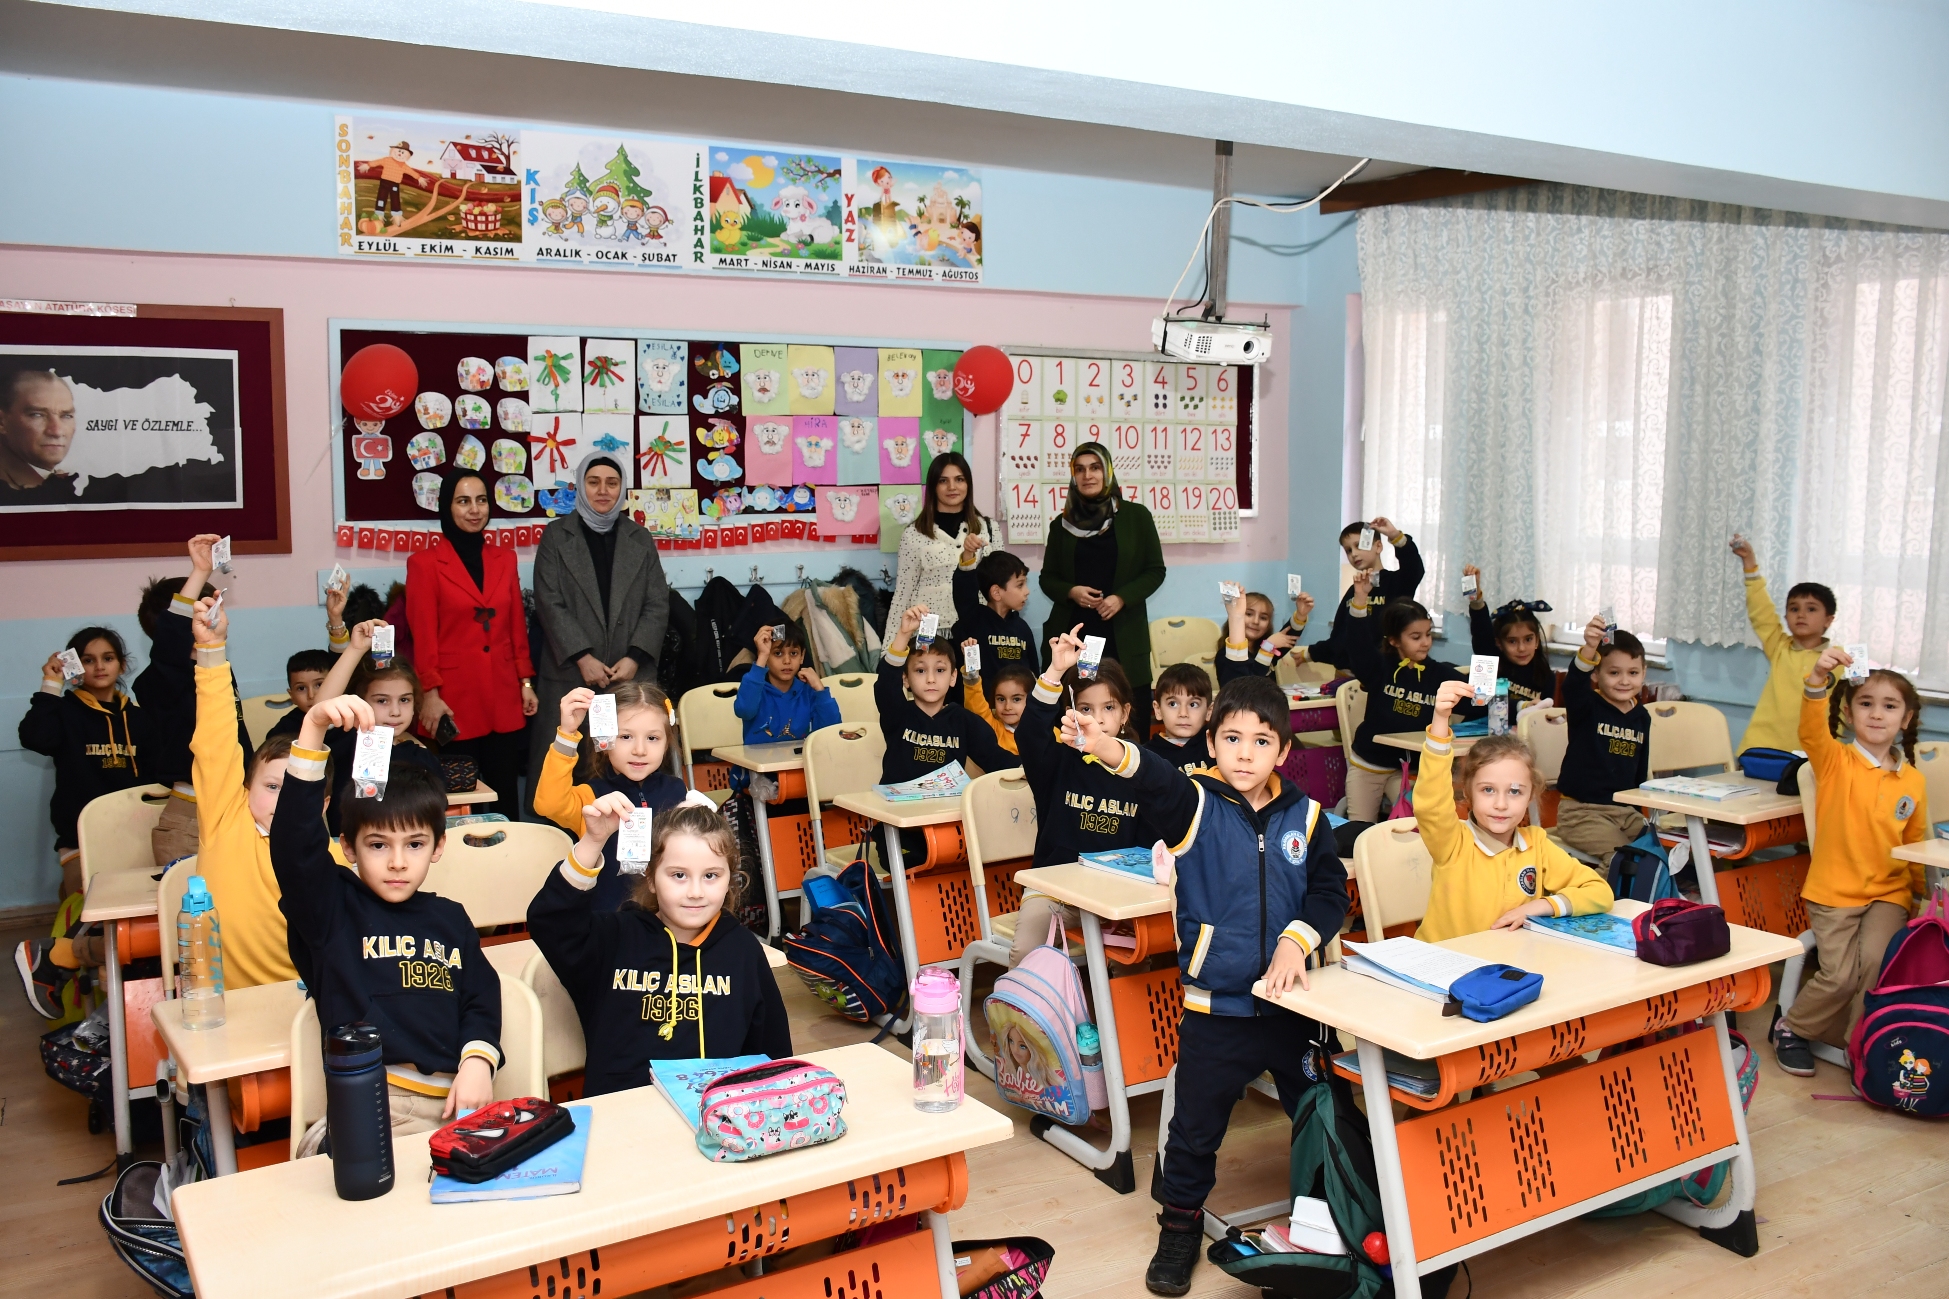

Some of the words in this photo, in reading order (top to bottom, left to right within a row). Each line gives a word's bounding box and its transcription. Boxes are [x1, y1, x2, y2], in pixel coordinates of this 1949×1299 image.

[337, 123, 353, 247] SONBAHAR
[525, 168, 539, 226] KIŞ
[692, 153, 705, 264] İLKBAHAR
[844, 193, 855, 243] YAZ
[358, 239, 400, 252] EYLÜL
[421, 241, 454, 254] EKİM
[475, 246, 515, 256] KASIM
[536, 247, 582, 258] ARALIK
[596, 250, 628, 260] OCAK
[641, 252, 677, 263] ŞUBAT
[718, 257, 751, 268] MART
[762, 257, 793, 269] NİSAN
[804, 262, 836, 272] MAYIS
[848, 262, 888, 275] HAZİRAN
[896, 268, 933, 278] TEMMUZ
[941, 268, 979, 280] AĞUSTOS
[1017, 359, 1033, 384] 0
[1055, 360, 1063, 386] 1
[1088, 362, 1100, 387] 2
[1121, 363, 1134, 388] 3
[1153, 365, 1168, 389] 4
[1186, 367, 1198, 391] 5
[1217, 369, 1229, 392] 6
[86, 419, 118, 432] SAYGI
[123, 419, 138, 431] VE
[141, 418, 203, 432] ÖZLEMLE...
[1018, 423, 1031, 448] 7
[1053, 423, 1066, 448] 8
[1089, 424, 1100, 443] 9
[1114, 425, 1139, 450] 10
[1151, 426, 1168, 450] 11
[1180, 427, 1202, 451] 12
[1211, 428, 1232, 451] 13
[1012, 483, 1039, 509] 14
[1149, 486, 1171, 510] 18
[1181, 486, 1202, 510] 19
[1209, 487, 1236, 511] 20
[913, 746, 946, 764] 1926
[1609, 738, 1637, 757] 1926
[1080, 812, 1120, 835] 1926
[362, 935, 416, 959] KILIÇ
[423, 938, 462, 969] ASLA
[399, 960, 454, 992] 1926
[612, 968, 661, 993] KILIÇ
[664, 974, 731, 995] ASLAN
[641, 994, 700, 1022] 1926
[996, 1056, 1044, 1093] Barbie
[494, 1167, 558, 1181] MATEM
